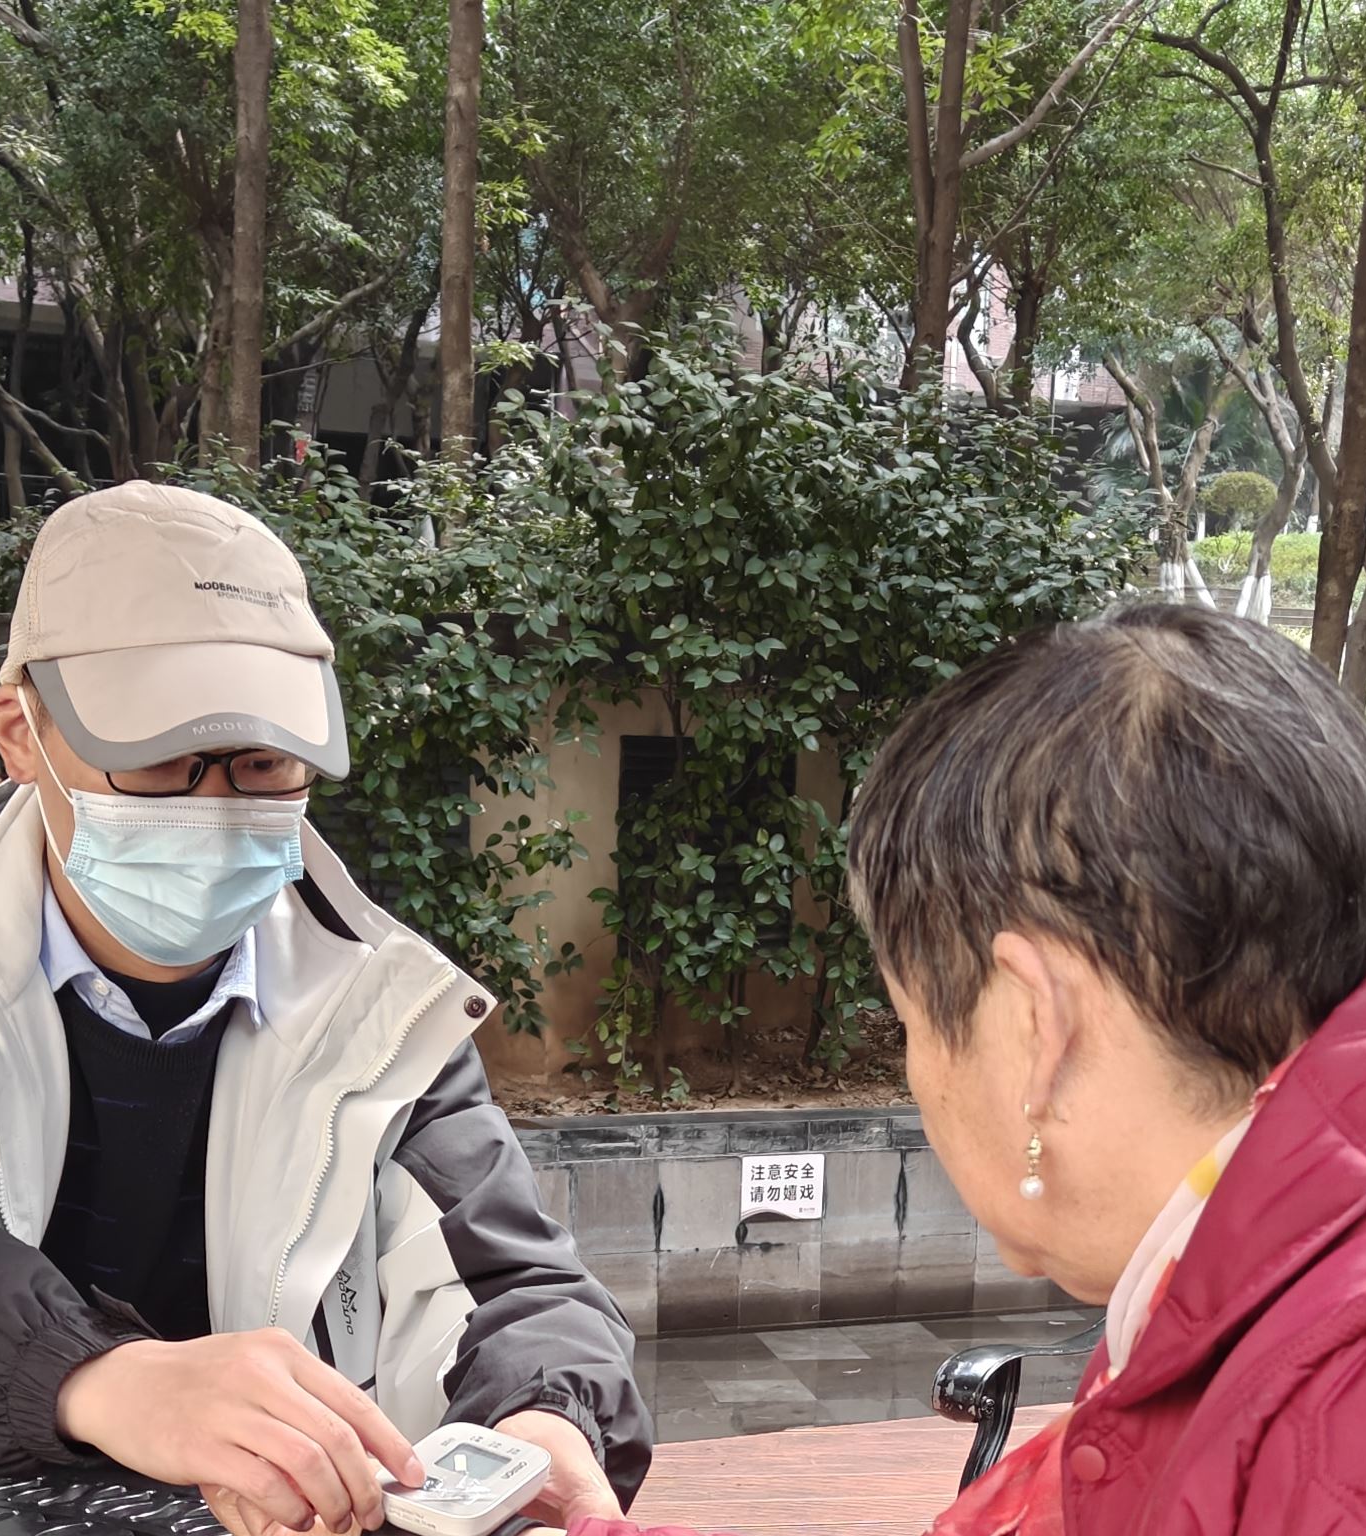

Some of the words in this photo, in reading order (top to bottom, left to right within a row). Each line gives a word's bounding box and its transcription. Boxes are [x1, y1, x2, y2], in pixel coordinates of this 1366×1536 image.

[750, 1162, 815, 1181] 注意安全
[750, 1184, 815, 1203] 请勿嬉戏
